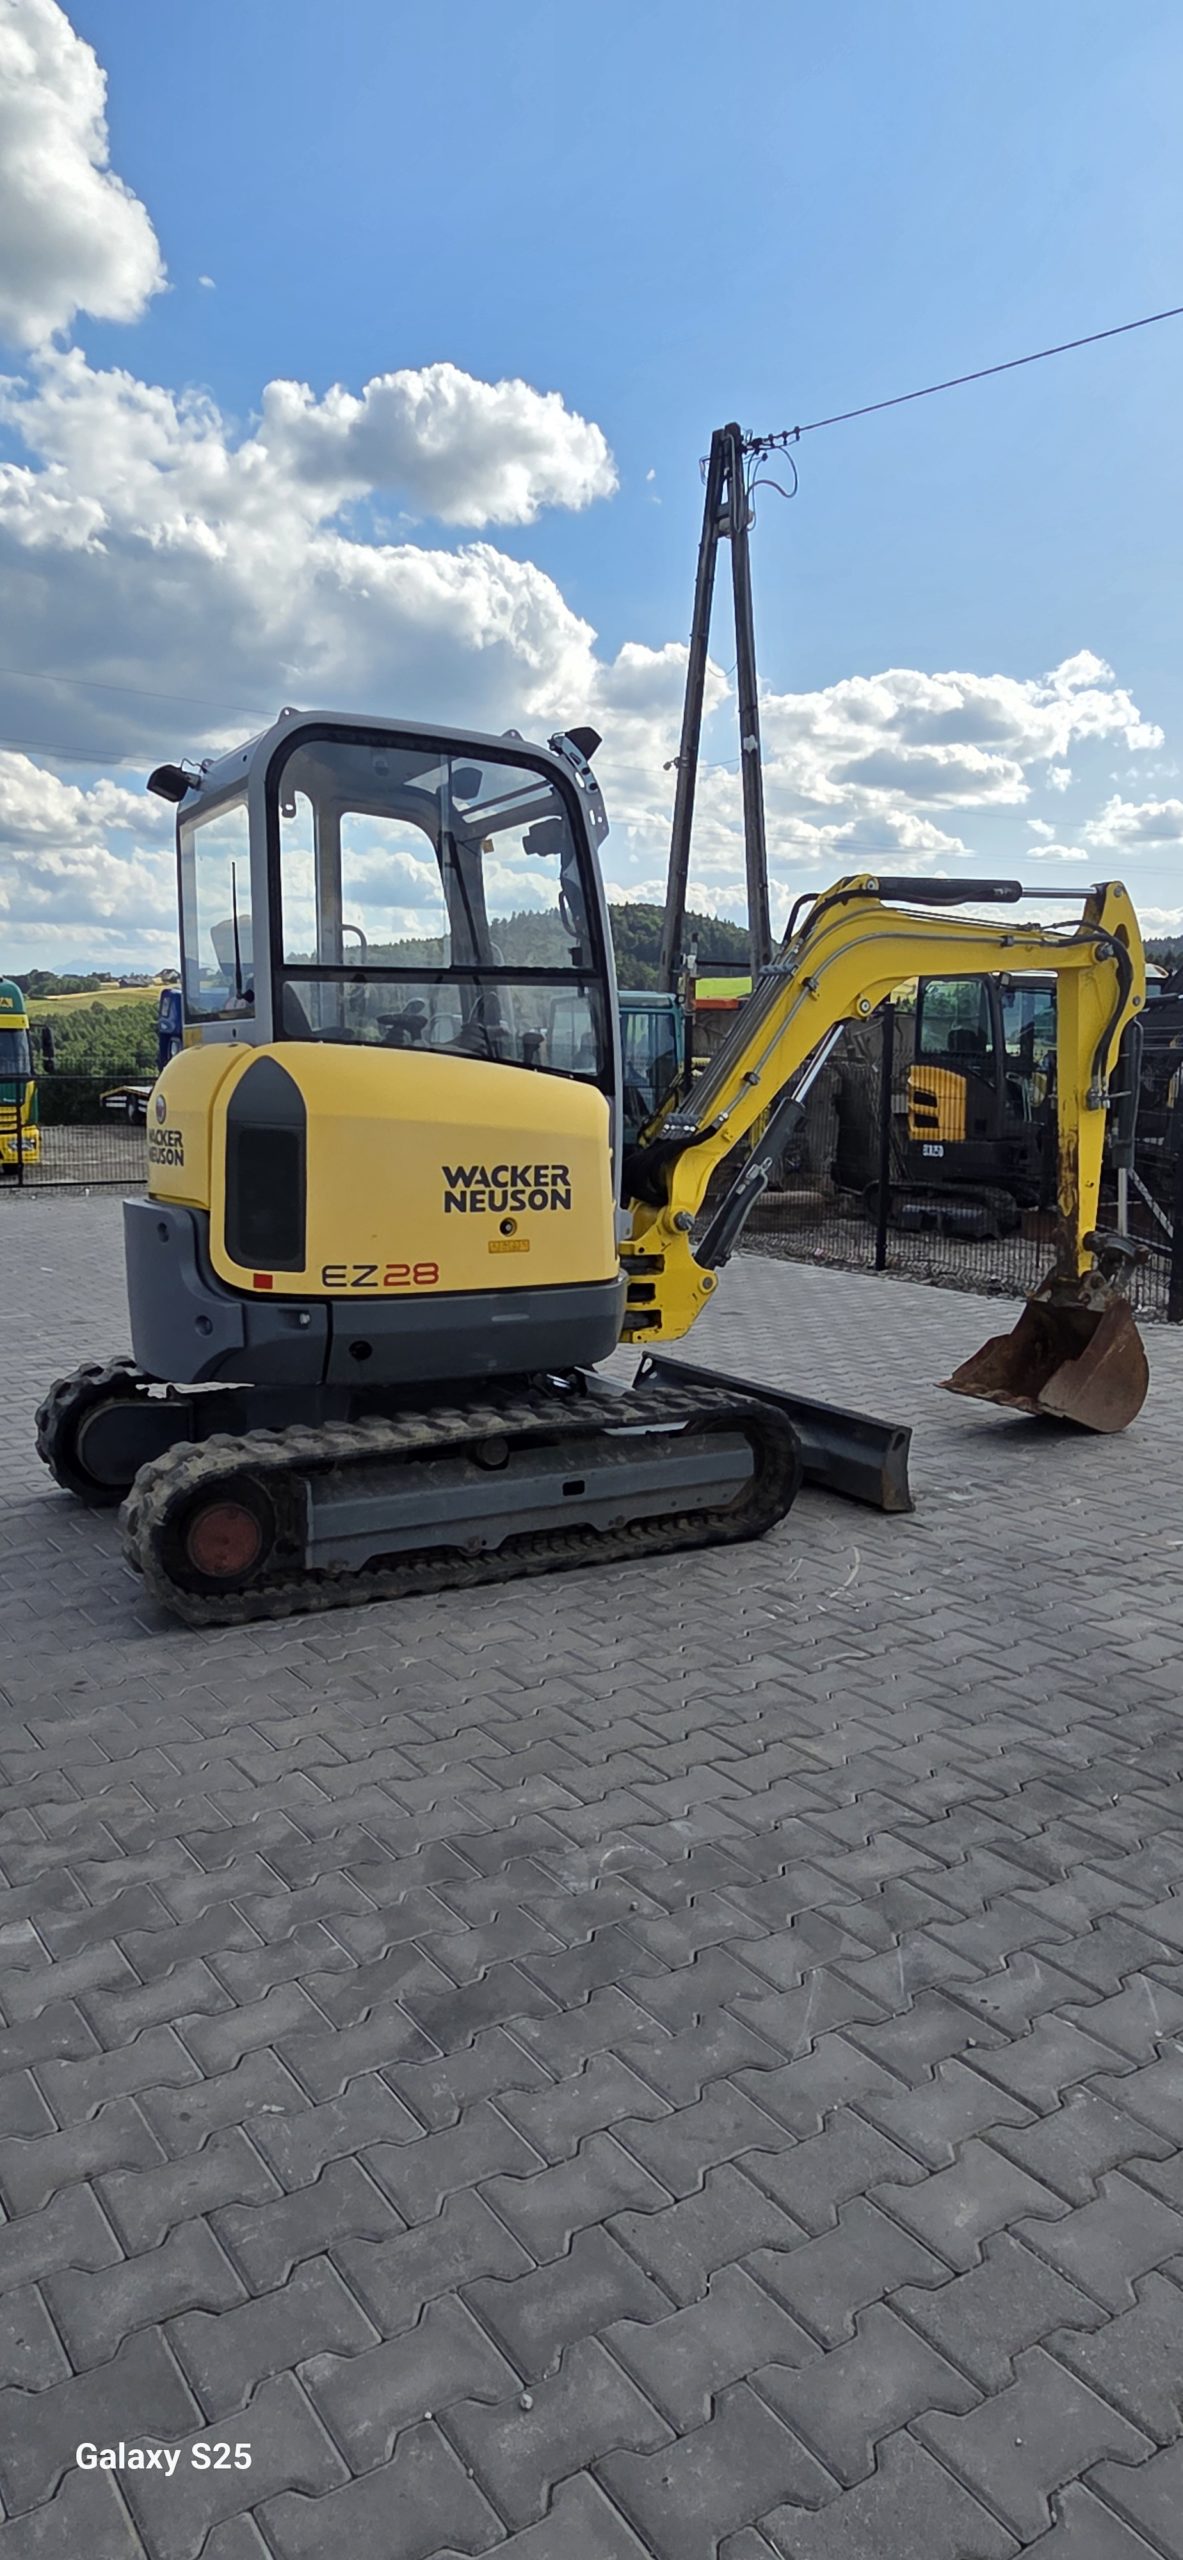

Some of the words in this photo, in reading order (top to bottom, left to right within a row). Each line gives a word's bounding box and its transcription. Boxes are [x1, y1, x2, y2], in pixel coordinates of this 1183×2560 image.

[149, 1147, 184, 1167] EUSON
[442, 1165, 571, 1188] WACKER
[444, 1188, 571, 1213] NEUSON
[322, 1262, 440, 1287] EZ28
